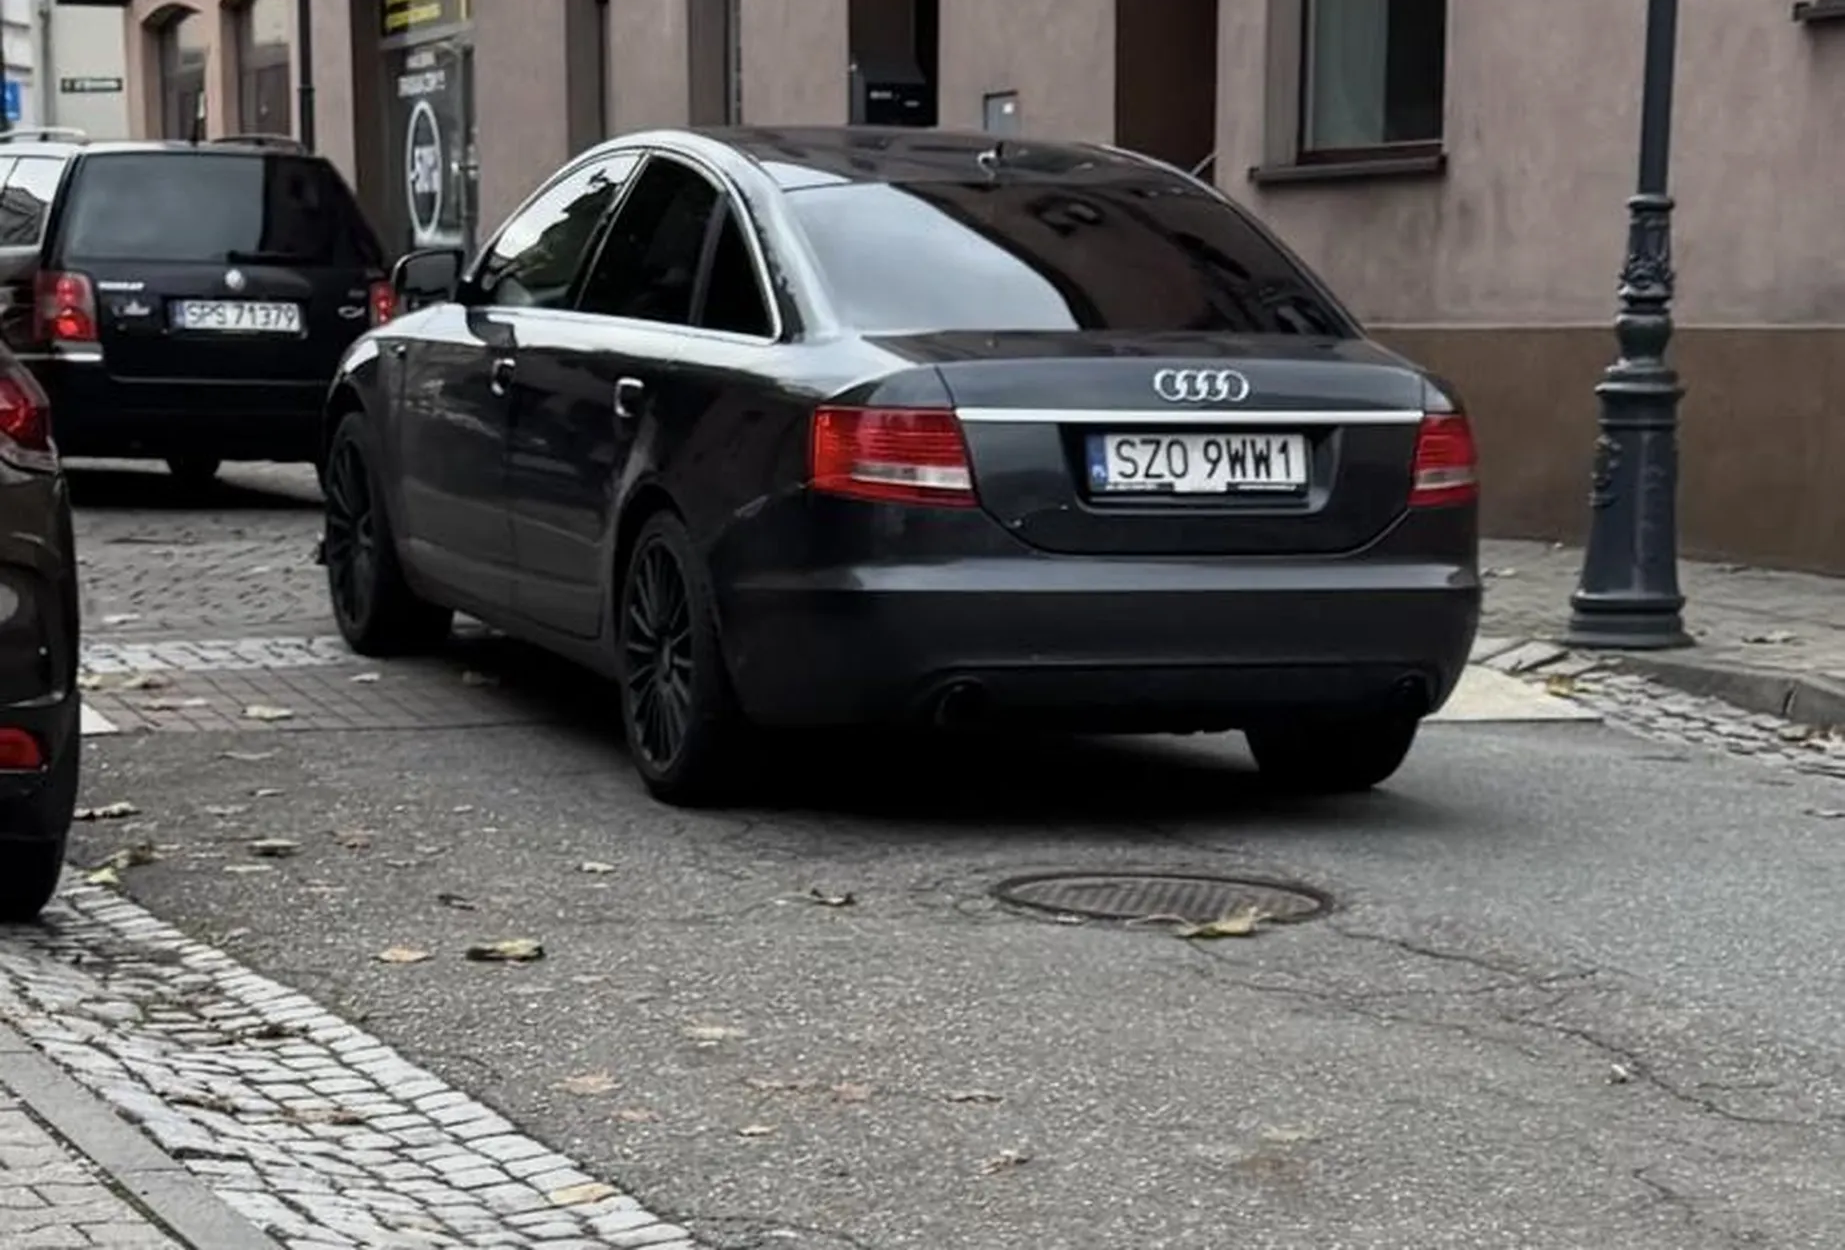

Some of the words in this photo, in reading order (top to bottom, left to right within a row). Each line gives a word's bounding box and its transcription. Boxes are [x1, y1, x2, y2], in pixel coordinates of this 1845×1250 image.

[187, 303, 227, 326] SPS
[233, 304, 297, 327] 71379
[1203, 438, 1291, 479] 9WW1
